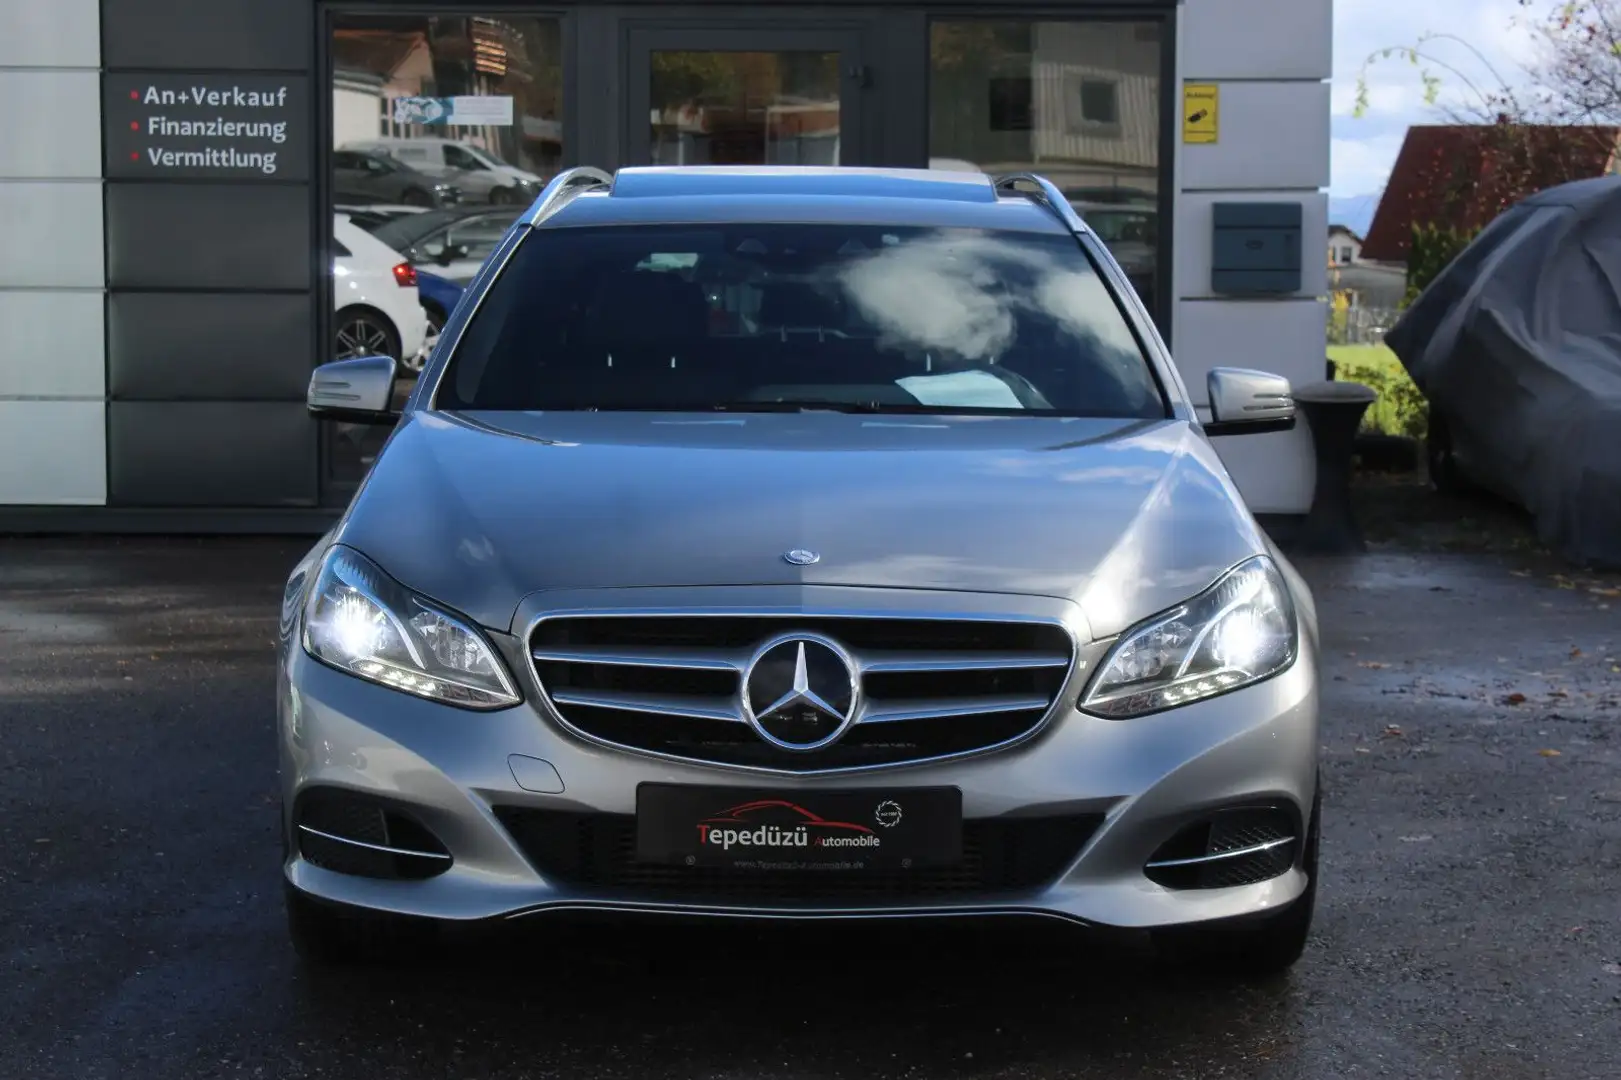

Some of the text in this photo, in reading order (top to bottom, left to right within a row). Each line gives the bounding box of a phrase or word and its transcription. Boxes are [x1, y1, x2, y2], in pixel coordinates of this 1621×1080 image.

[143, 86, 287, 107] An+Verkauf
[148, 116, 287, 143] Finanzierung
[148, 147, 277, 173] Vermittlung
[697, 825, 881, 849] Tepedüzü Automobile
